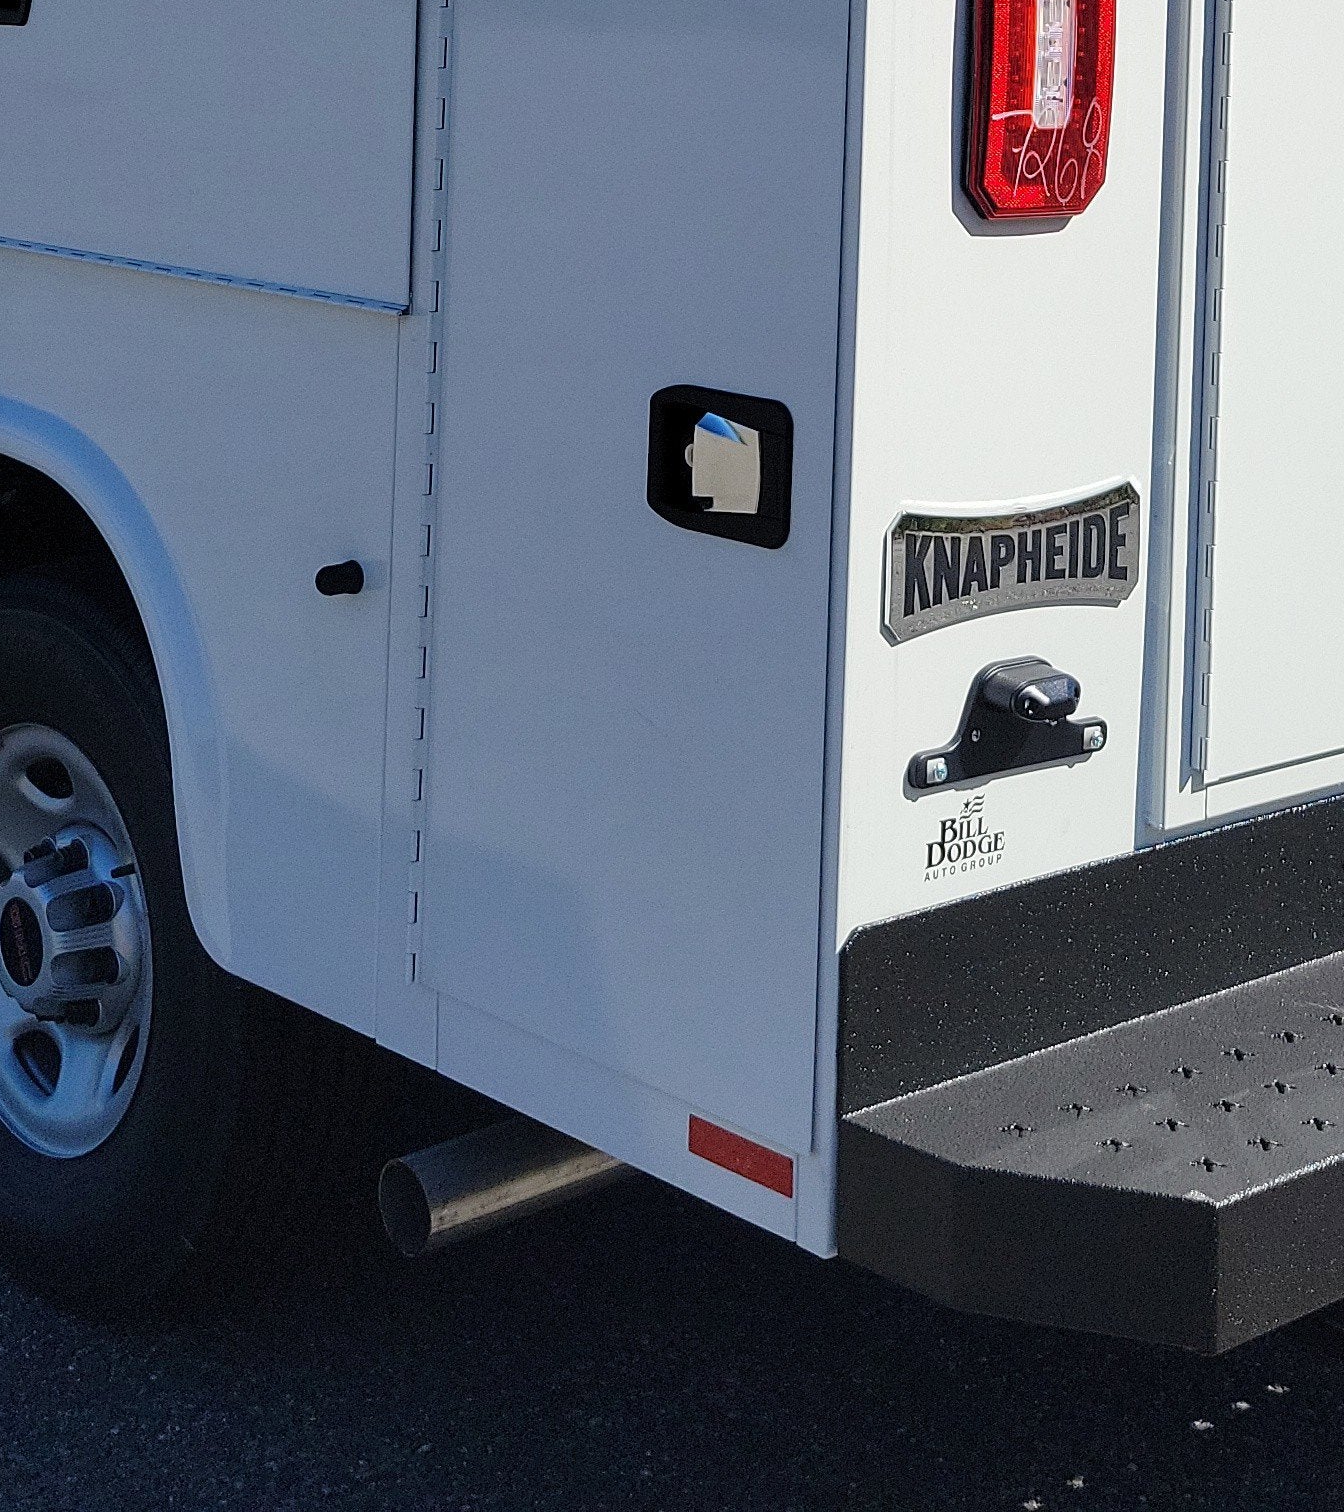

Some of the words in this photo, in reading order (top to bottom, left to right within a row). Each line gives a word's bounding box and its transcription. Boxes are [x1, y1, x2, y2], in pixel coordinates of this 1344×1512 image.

[903, 498, 1132, 619] KNAPHEIDE
[939, 816, 989, 844] BILL
[925, 830, 1005, 869] DODGE
[924, 865, 956, 883] AUTO
[960, 853, 1003, 873] GROUP
